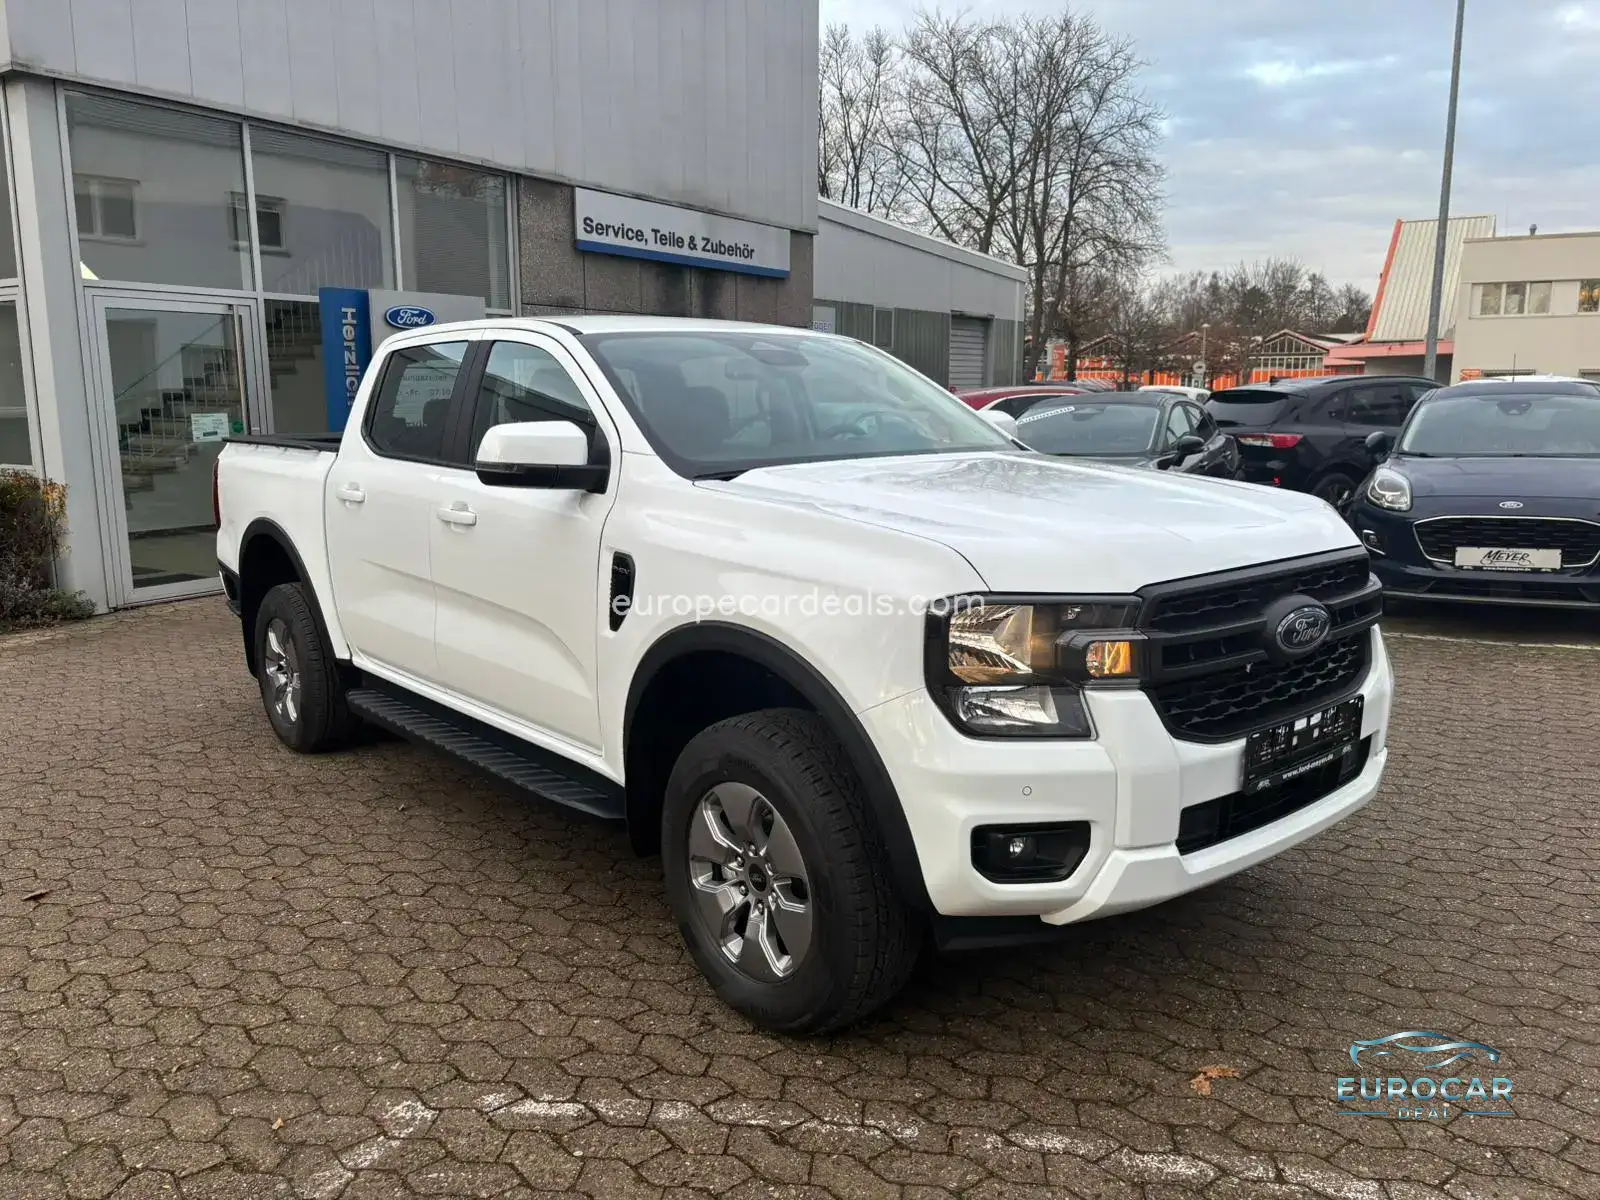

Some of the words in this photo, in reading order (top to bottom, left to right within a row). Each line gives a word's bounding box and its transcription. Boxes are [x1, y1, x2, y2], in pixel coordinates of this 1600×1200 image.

[583, 217, 648, 245] Service,
[651, 228, 684, 249] Teile
[688, 236, 697, 250] &
[701, 237, 755, 259] Zubehör
[397, 309, 427, 325] Ford
[1482, 550, 1530, 561] MEYER
[1292, 617, 1322, 643] Ford
